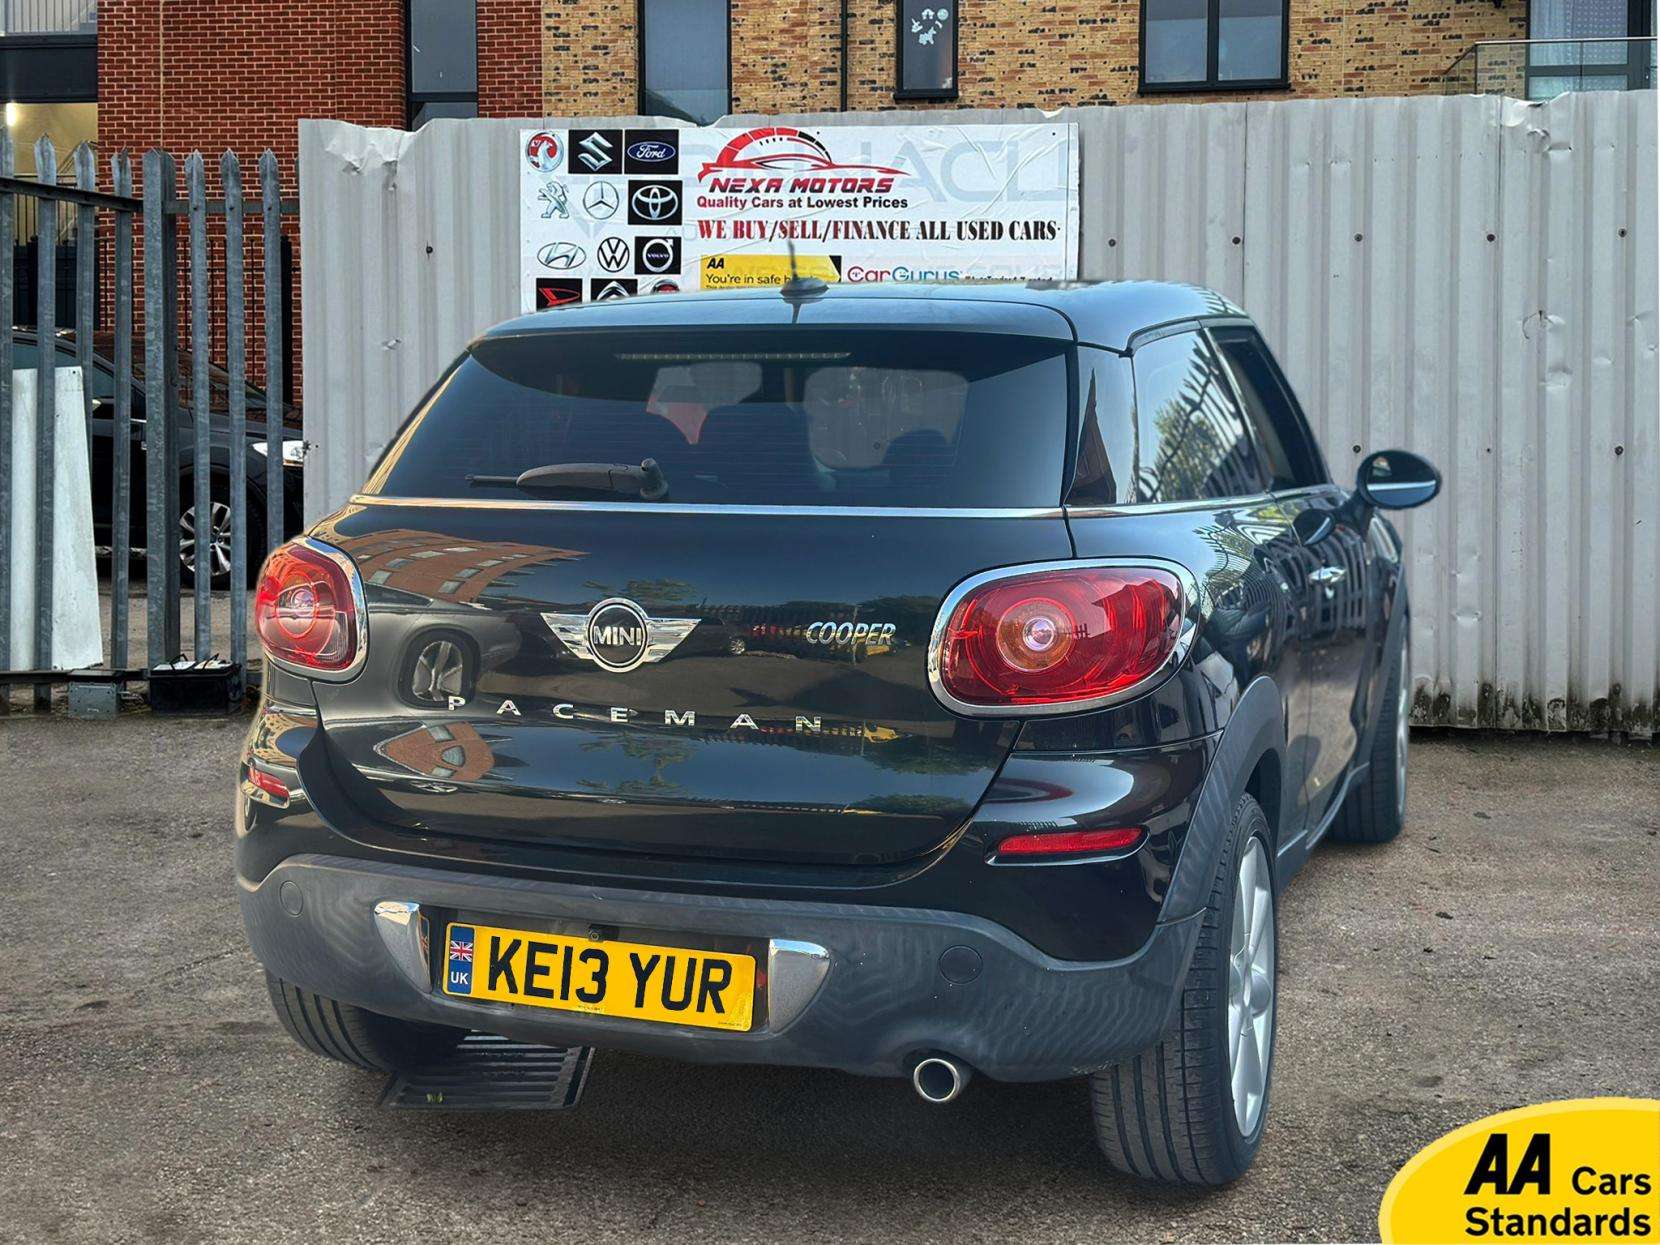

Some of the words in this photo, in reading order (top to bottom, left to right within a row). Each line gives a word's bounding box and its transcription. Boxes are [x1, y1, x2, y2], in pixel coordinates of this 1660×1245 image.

[636, 144, 666, 159] Ford
[708, 177, 784, 193] NEXA
[789, 177, 894, 193] MOTORS
[697, 195, 746, 211] Quality
[752, 196, 784, 208] Cars
[788, 197, 802, 208] at
[807, 196, 858, 208] Lowest
[863, 196, 908, 208] Prices
[697, 220, 726, 239] WE
[733, 219, 911, 243] BUY/SELL/FINANCE
[916, 220, 951, 240] ALL
[957, 220, 1004, 241] USED
[707, 257, 725, 269] AA
[706, 273, 741, 284] You're
[744, 274, 754, 284] in
[757, 273, 782, 285] safe
[847, 266, 961, 282] CarGurus
[593, 626, 642, 646] MINI
[806, 621, 897, 646] COOPER
[451, 971, 469, 985] UK
[488, 935, 609, 1004] KE13
[629, 952, 733, 1014] YUR
